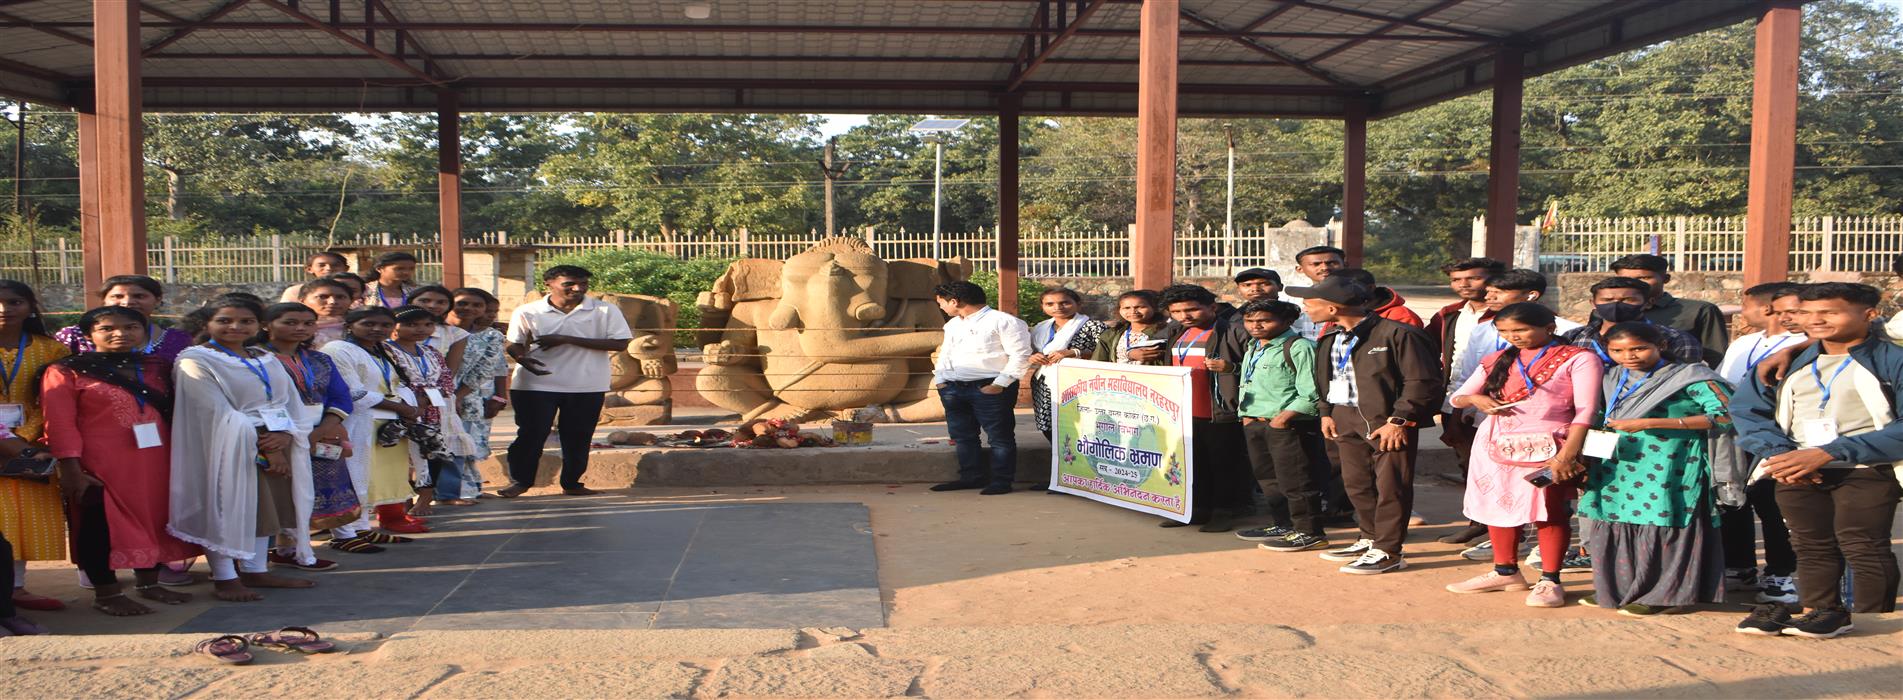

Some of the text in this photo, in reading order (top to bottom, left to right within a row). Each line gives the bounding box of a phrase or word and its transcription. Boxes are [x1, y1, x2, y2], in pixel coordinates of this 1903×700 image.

[1089, 375, 1106, 392] नवीन
[1150, 388, 1180, 421] नरहरपुर
[1118, 421, 1139, 436] विभाग
[1077, 435, 1162, 468] भौगोलिक भ्रमण
[1114, 468, 1138, 478] 2024-25
[1062, 473, 1087, 486] आपका
[1088, 477, 1111, 491] हार्दिक
[1151, 493, 1174, 506] करता
[1175, 495, 1181, 509] है
